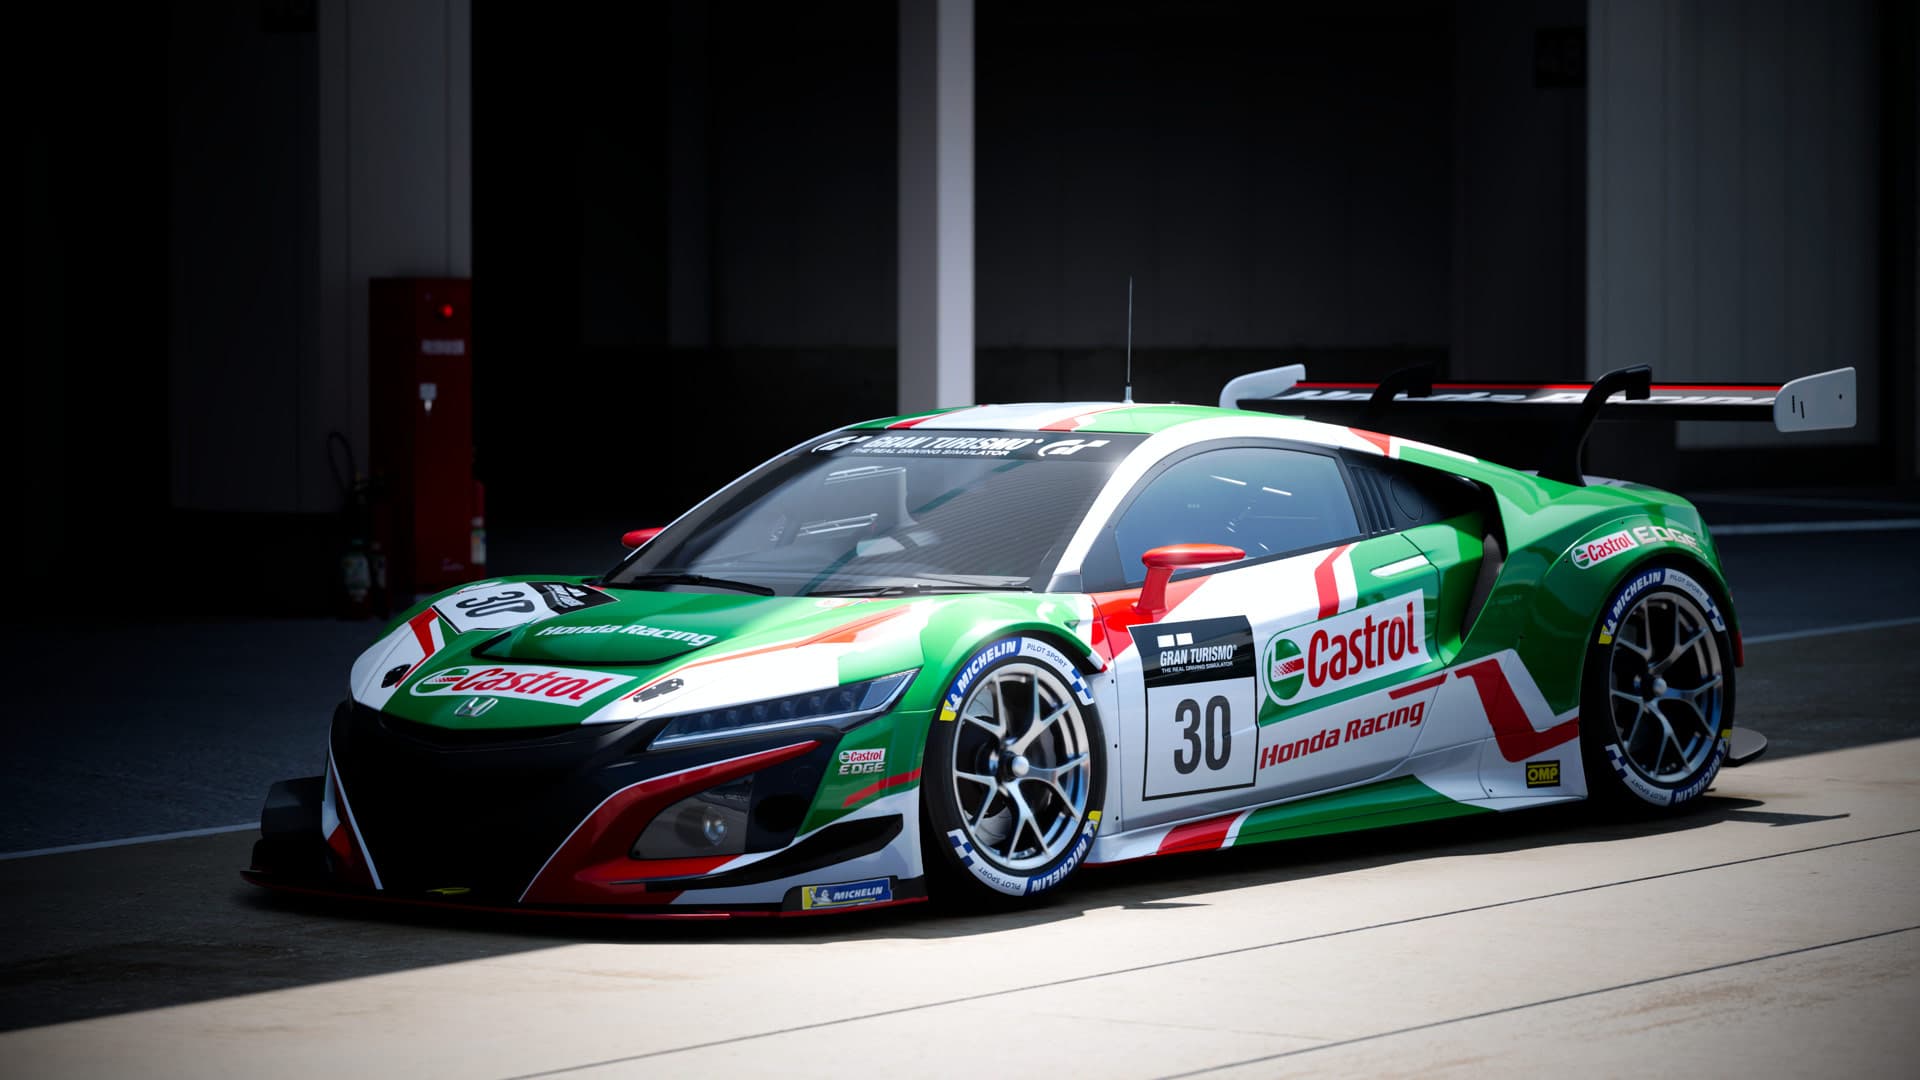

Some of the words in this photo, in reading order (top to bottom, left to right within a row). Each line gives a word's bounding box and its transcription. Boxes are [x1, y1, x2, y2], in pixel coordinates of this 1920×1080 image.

[862, 436, 933, 448] GRAN
[1588, 533, 1636, 562] Castrol
[1632, 526, 1703, 554] EDGE
[455, 591, 535, 618] 30
[1612, 571, 1662, 618] MICHELIN
[534, 624, 623, 637] Honda
[617, 624, 718, 647] Racing
[1308, 601, 1420, 689] Castrol
[957, 640, 1017, 694] MICHELIN
[1027, 643, 1046, 653] PILOT
[1046, 651, 1068, 668] SPORT
[1160, 649, 1188, 667] GRAN
[1206, 661, 1233, 669] SIMULATOR
[451, 667, 613, 700] Castrol
[1174, 695, 1231, 775] 30
[1259, 728, 1341, 770] Honda
[1344, 701, 1425, 743] Racing
[851, 750, 883, 762] Castrol
[839, 762, 886, 775] EDGE
[1527, 767, 1558, 782] OMP
[978, 867, 1000, 883] SPORT
[1031, 838, 1088, 892] MICHELIN
[833, 886, 883, 901] MICHELIN
[1000, 880, 1022, 890] PILOT
